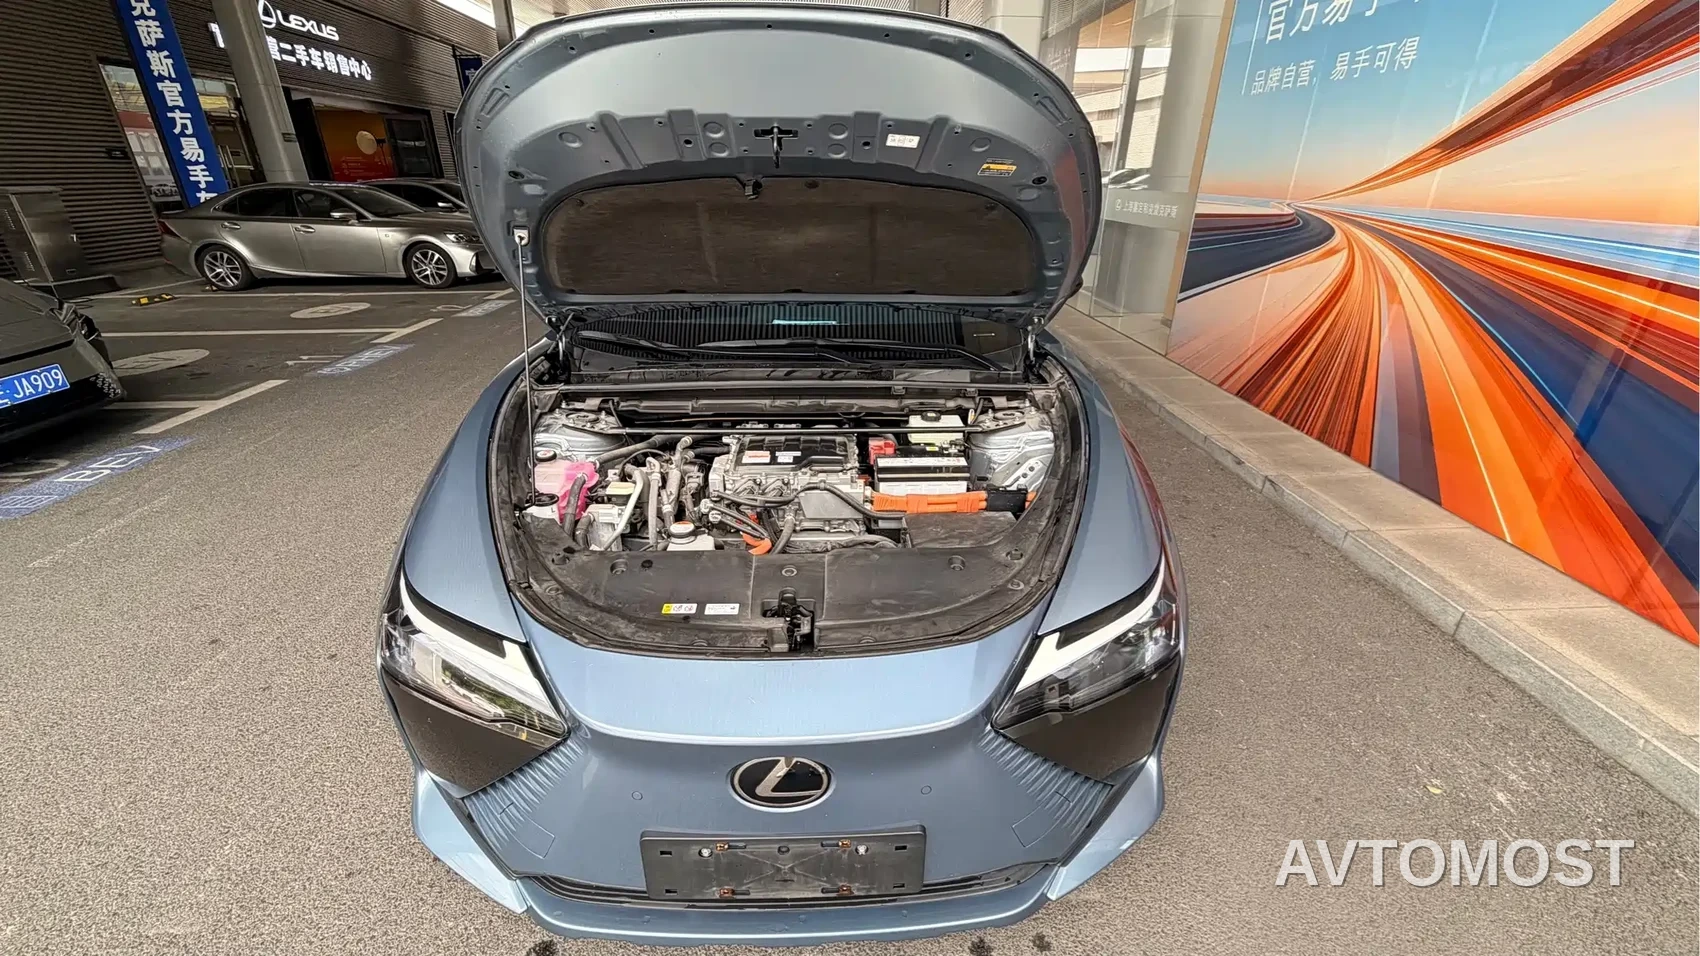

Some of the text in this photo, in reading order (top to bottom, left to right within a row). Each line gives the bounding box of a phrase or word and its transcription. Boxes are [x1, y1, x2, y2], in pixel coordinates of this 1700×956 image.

[276, 9, 340, 41] LEXUS
[1330, 36, 1420, 81] 易手可得
[54, 445, 162, 482] BEV
